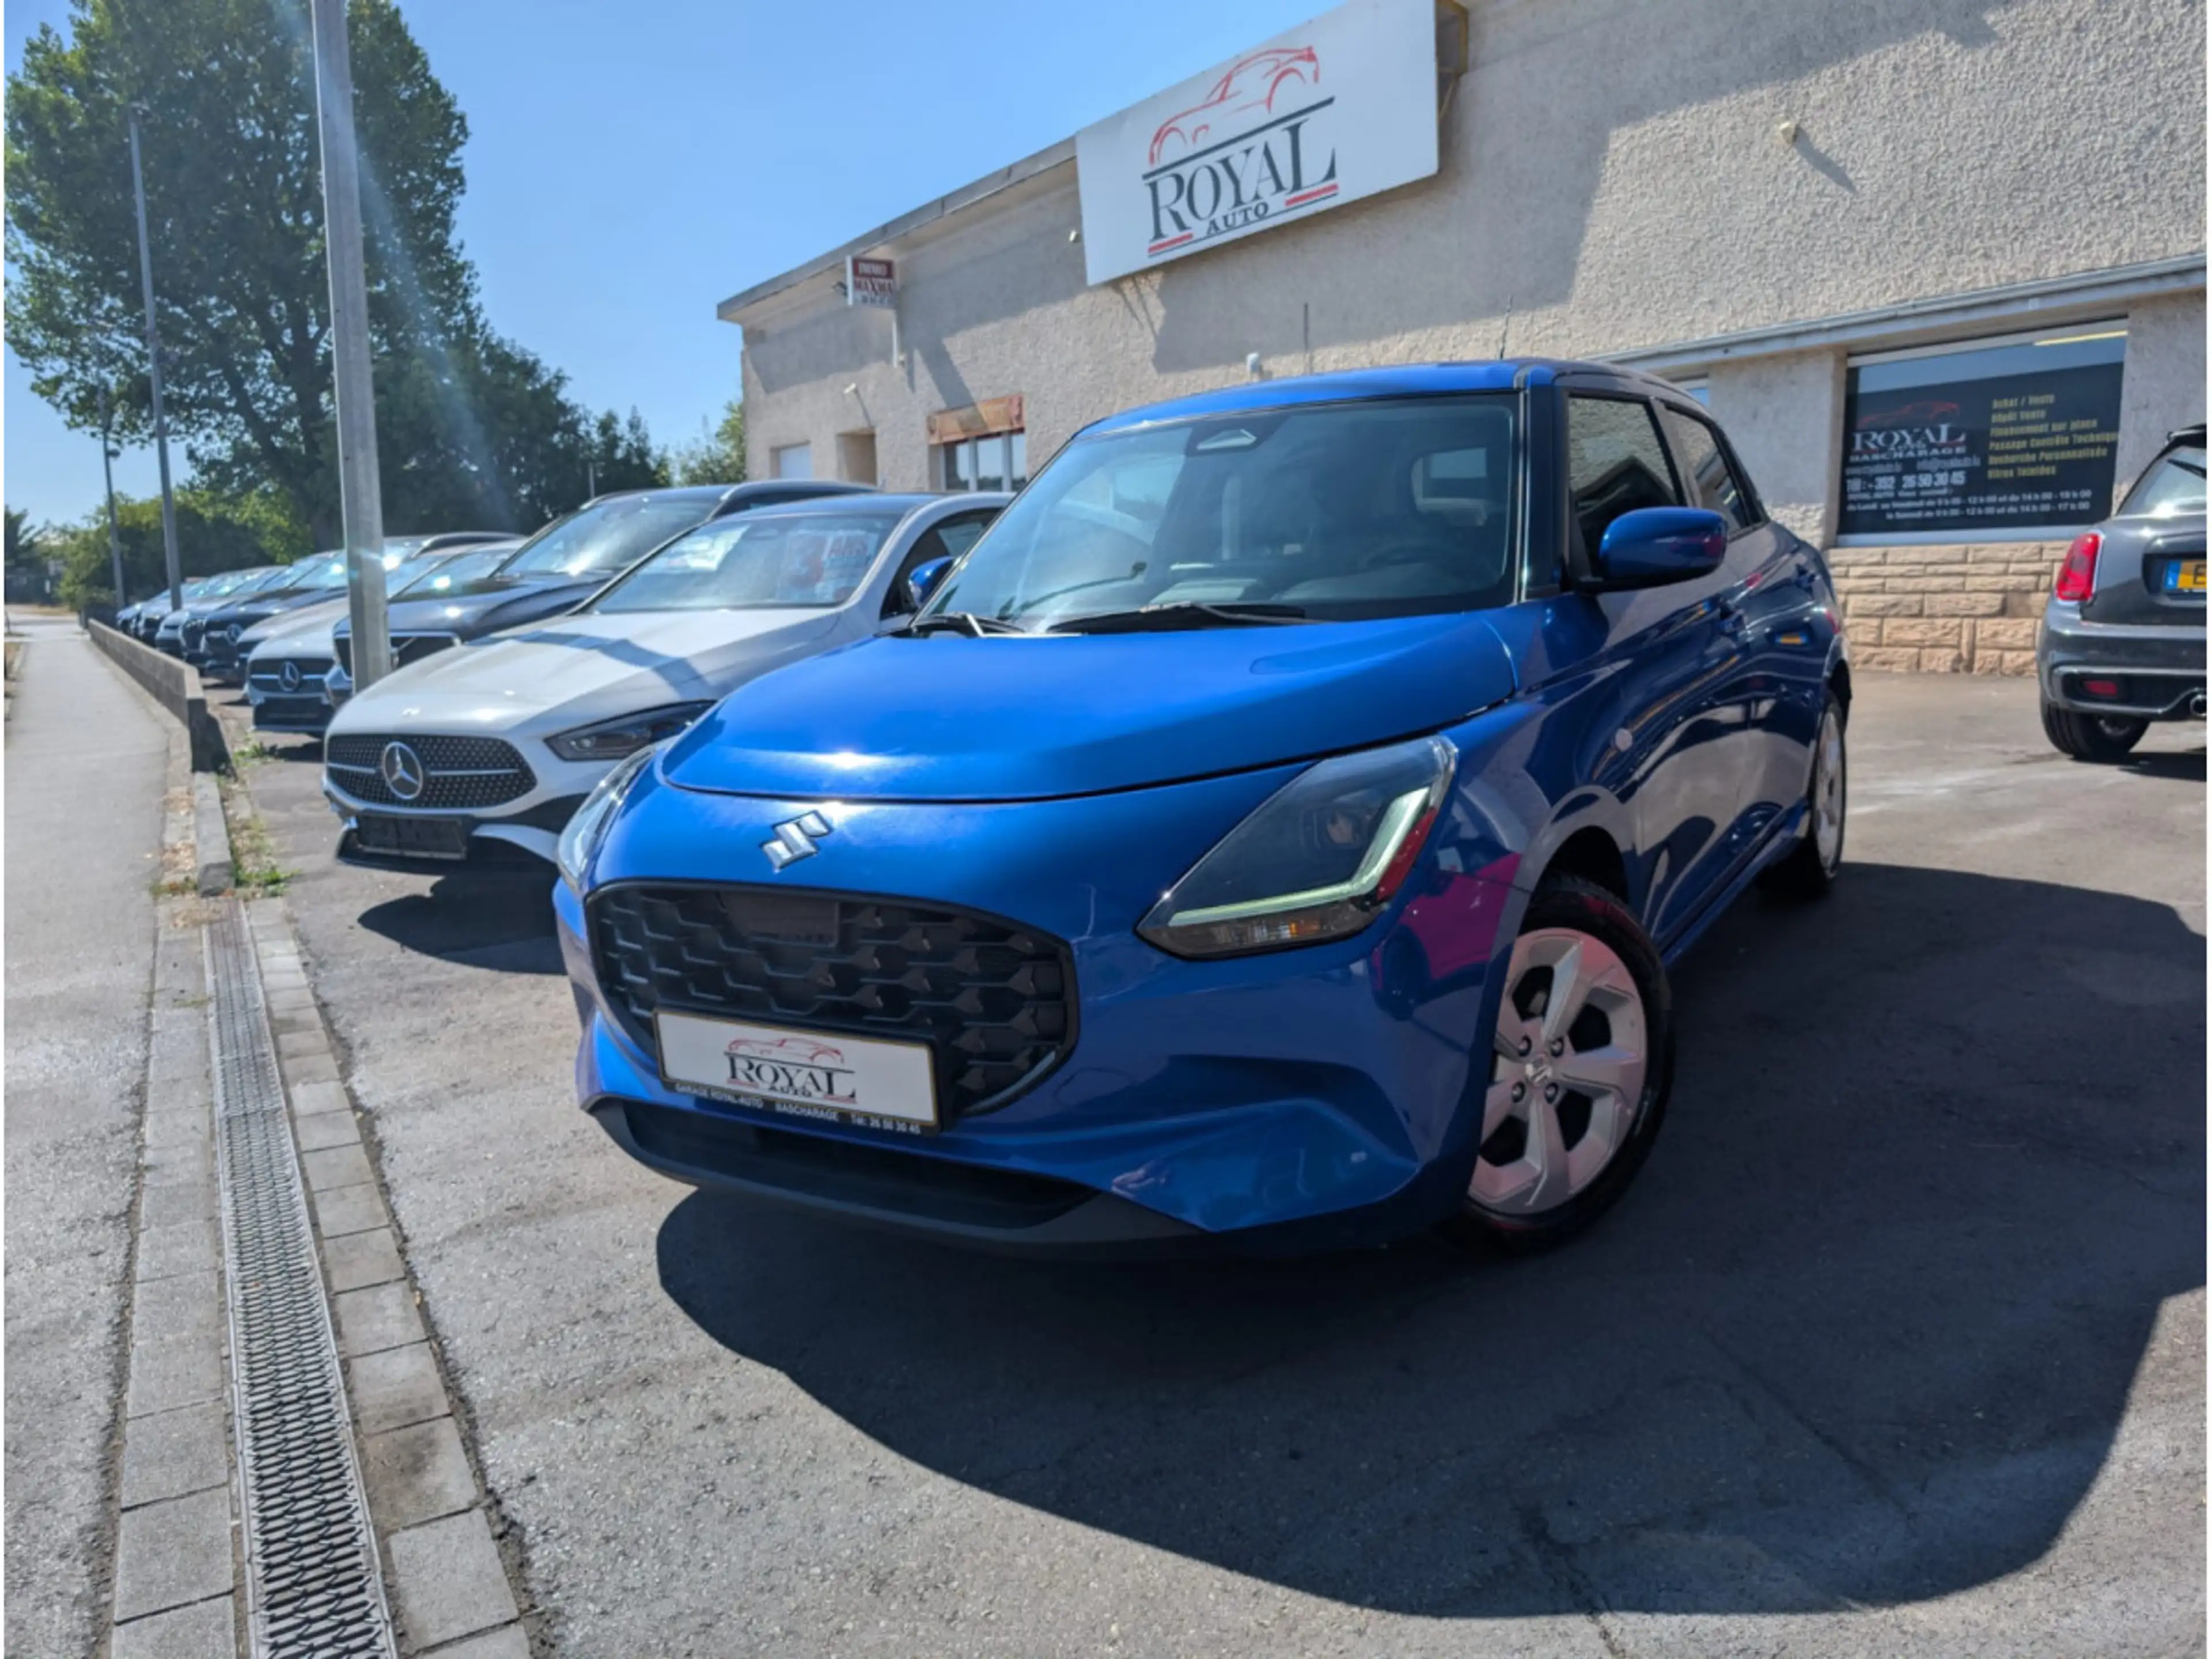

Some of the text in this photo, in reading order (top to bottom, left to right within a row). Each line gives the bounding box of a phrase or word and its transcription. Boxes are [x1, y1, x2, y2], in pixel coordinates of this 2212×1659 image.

[1143, 118, 1336, 244] ROYAL
[1206, 201, 1270, 236] AUTO
[1853, 423, 1966, 450] ROYAL
[1988, 439, 2027, 450] Passage
[1849, 445, 1967, 463] BASCHARAGE
[728, 1055, 857, 1099] ROYAL
[768, 1084, 813, 1098] AUTO
[775, 1102, 840, 1122] BASCHARAGE
